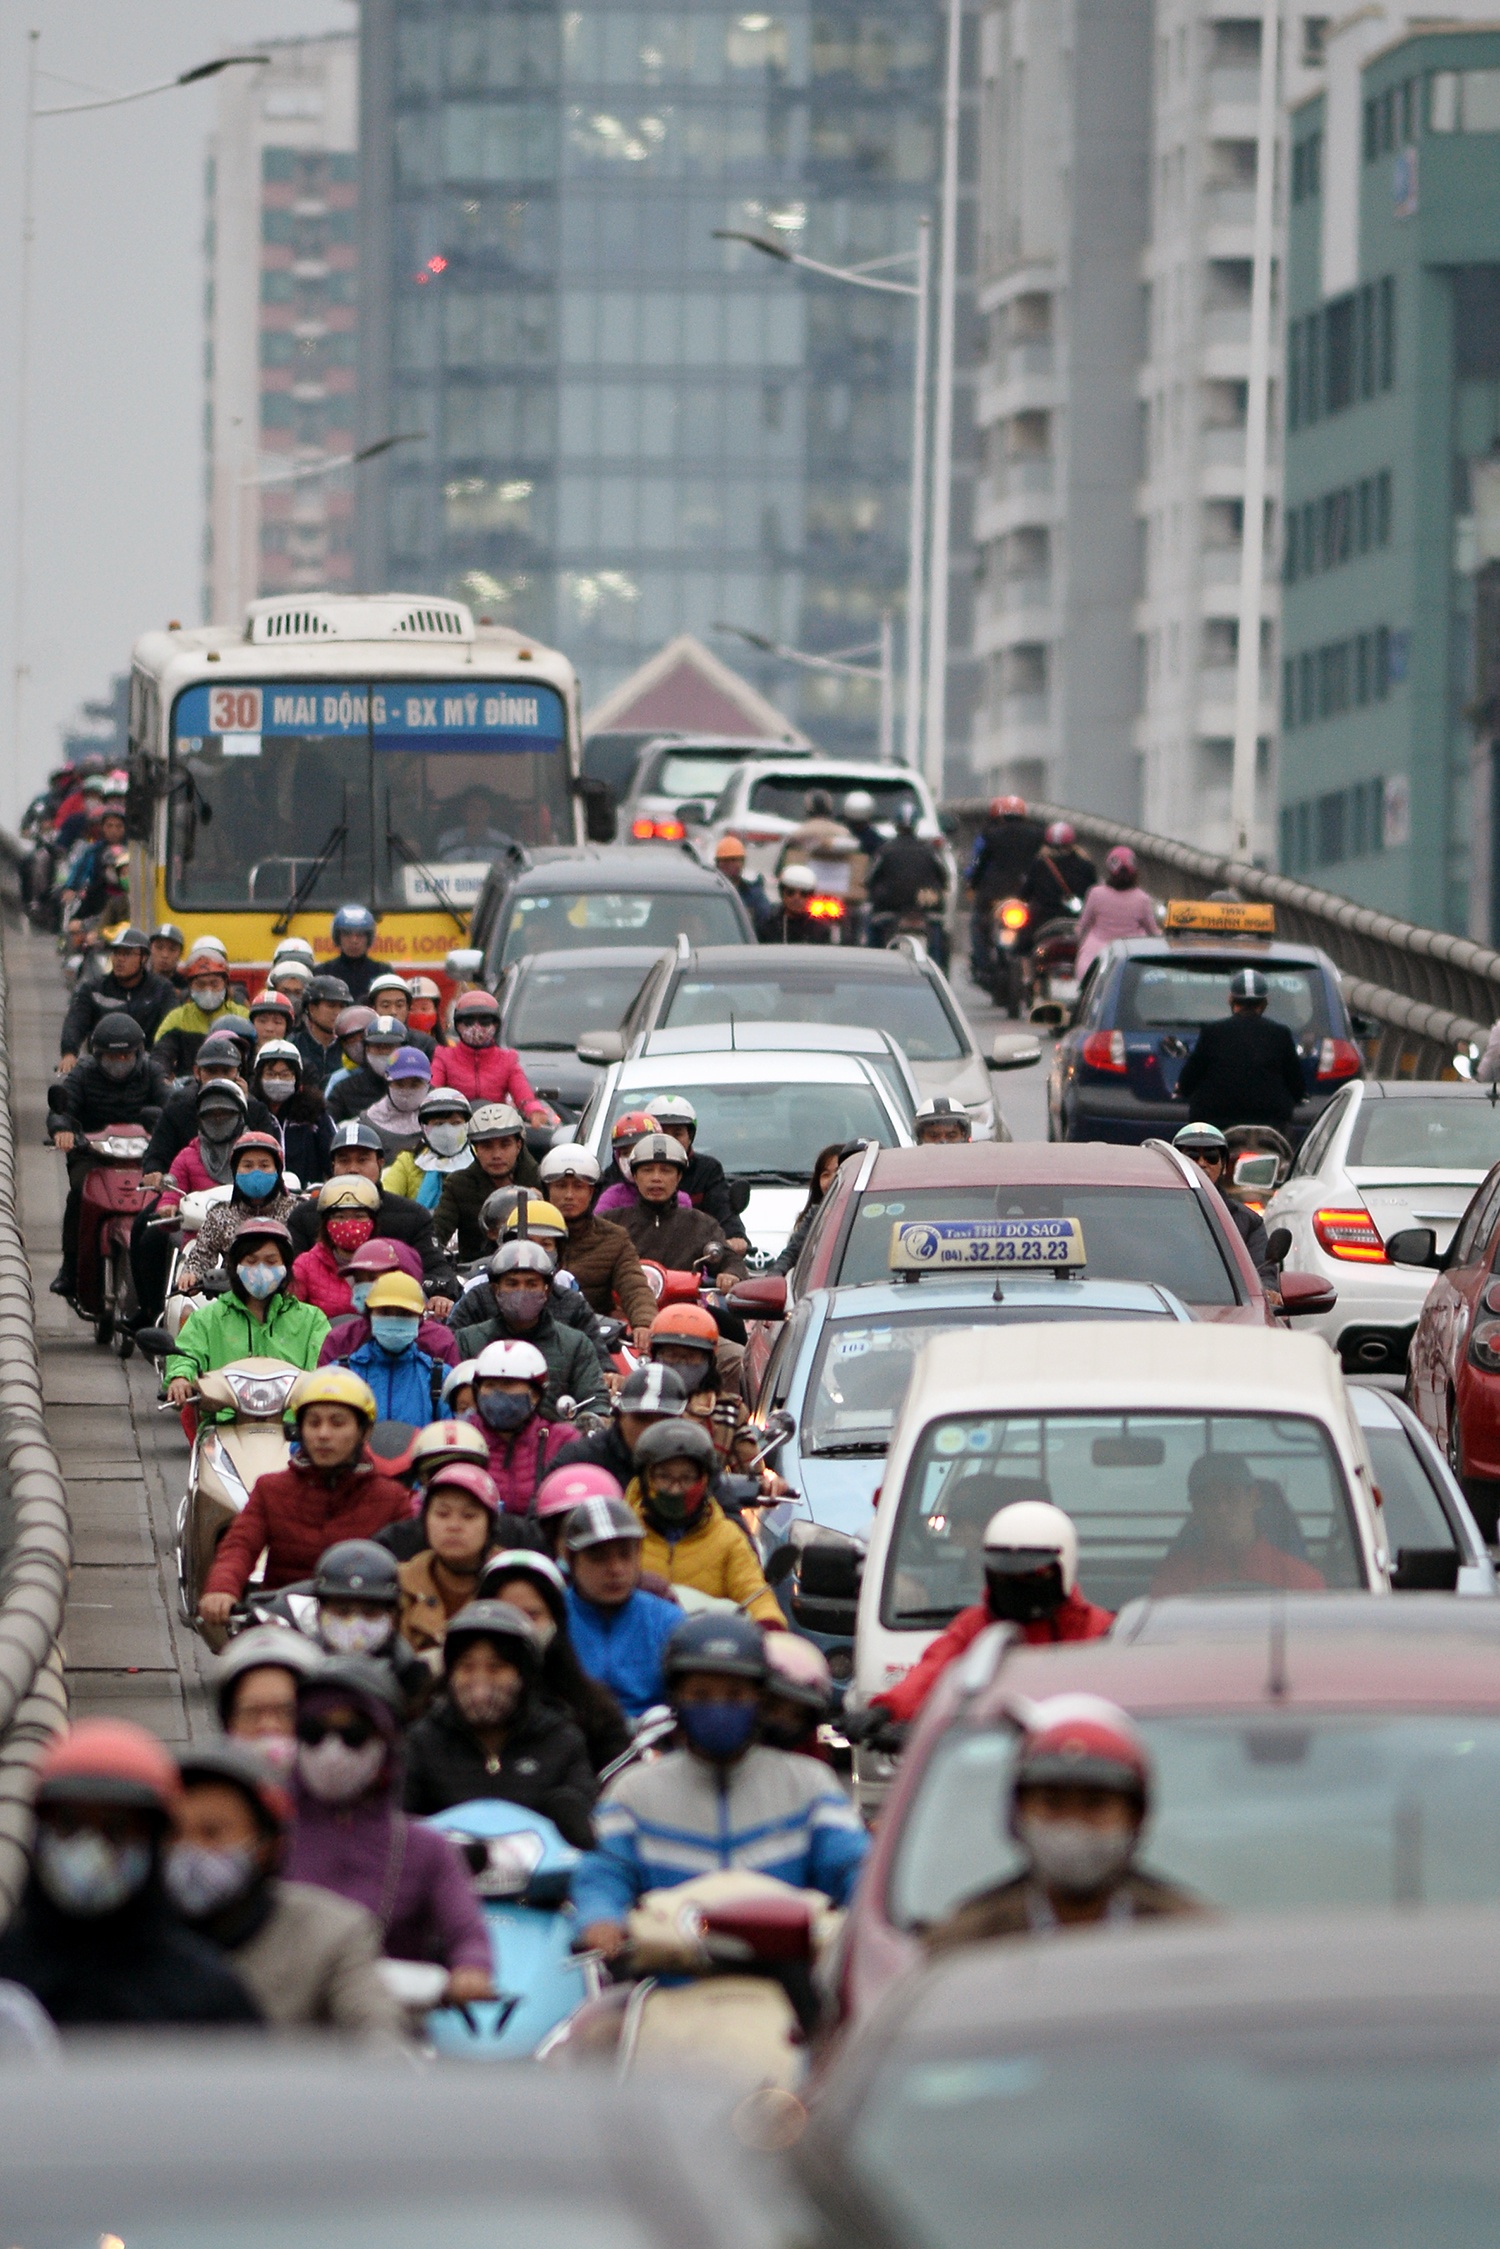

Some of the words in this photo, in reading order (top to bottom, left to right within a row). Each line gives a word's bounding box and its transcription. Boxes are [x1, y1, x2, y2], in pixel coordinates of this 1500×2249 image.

[215, 692, 258, 729] 30
[273, 697, 316, 725] MAI
[406, 698, 437, 726] BX
[946, 1229, 971, 1239] Taxi
[1031, 1223, 1060, 1237] SAO
